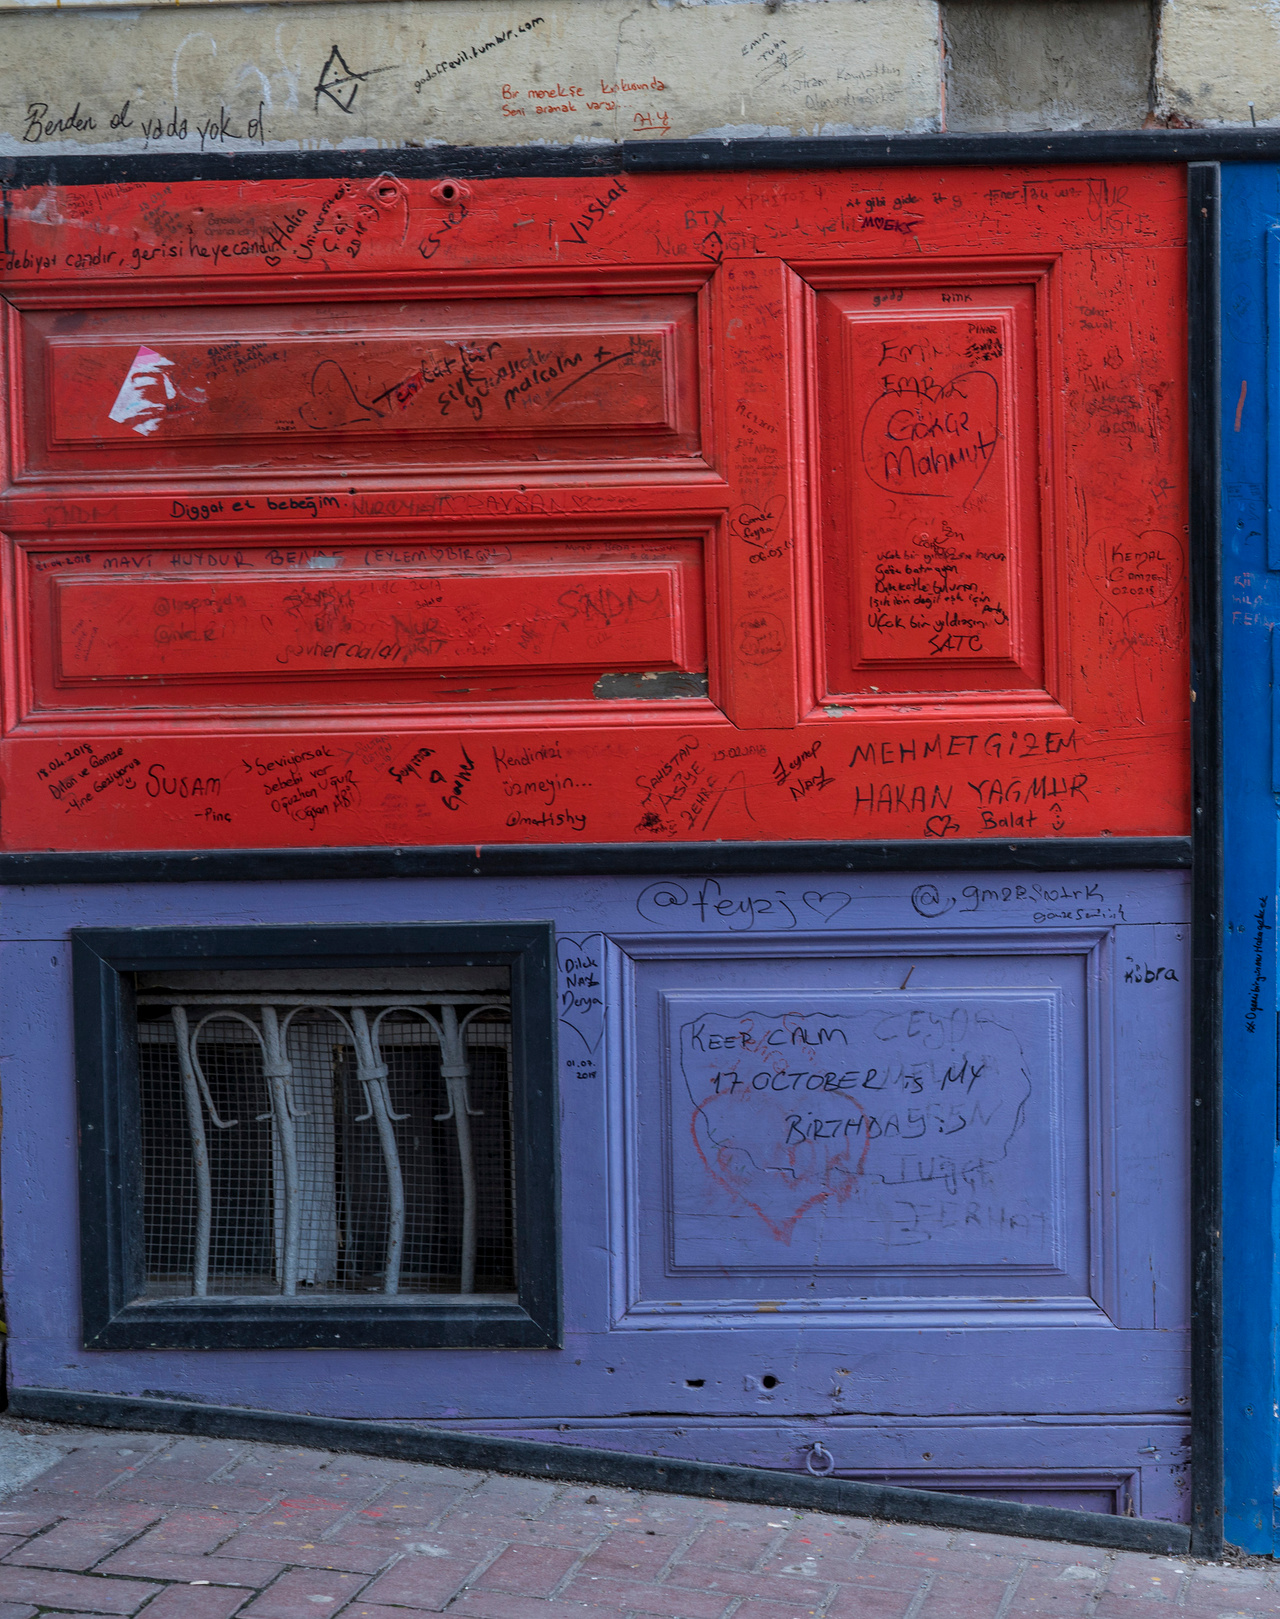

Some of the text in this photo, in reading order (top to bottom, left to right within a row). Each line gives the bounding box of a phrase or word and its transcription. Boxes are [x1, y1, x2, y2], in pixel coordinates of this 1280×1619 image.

[22, 101, 97, 143] Benden
[852, 782, 956, 819] HAKAN
[766, 1025, 849, 1047] CALM
[751, 1068, 885, 1093] OCTOBER
